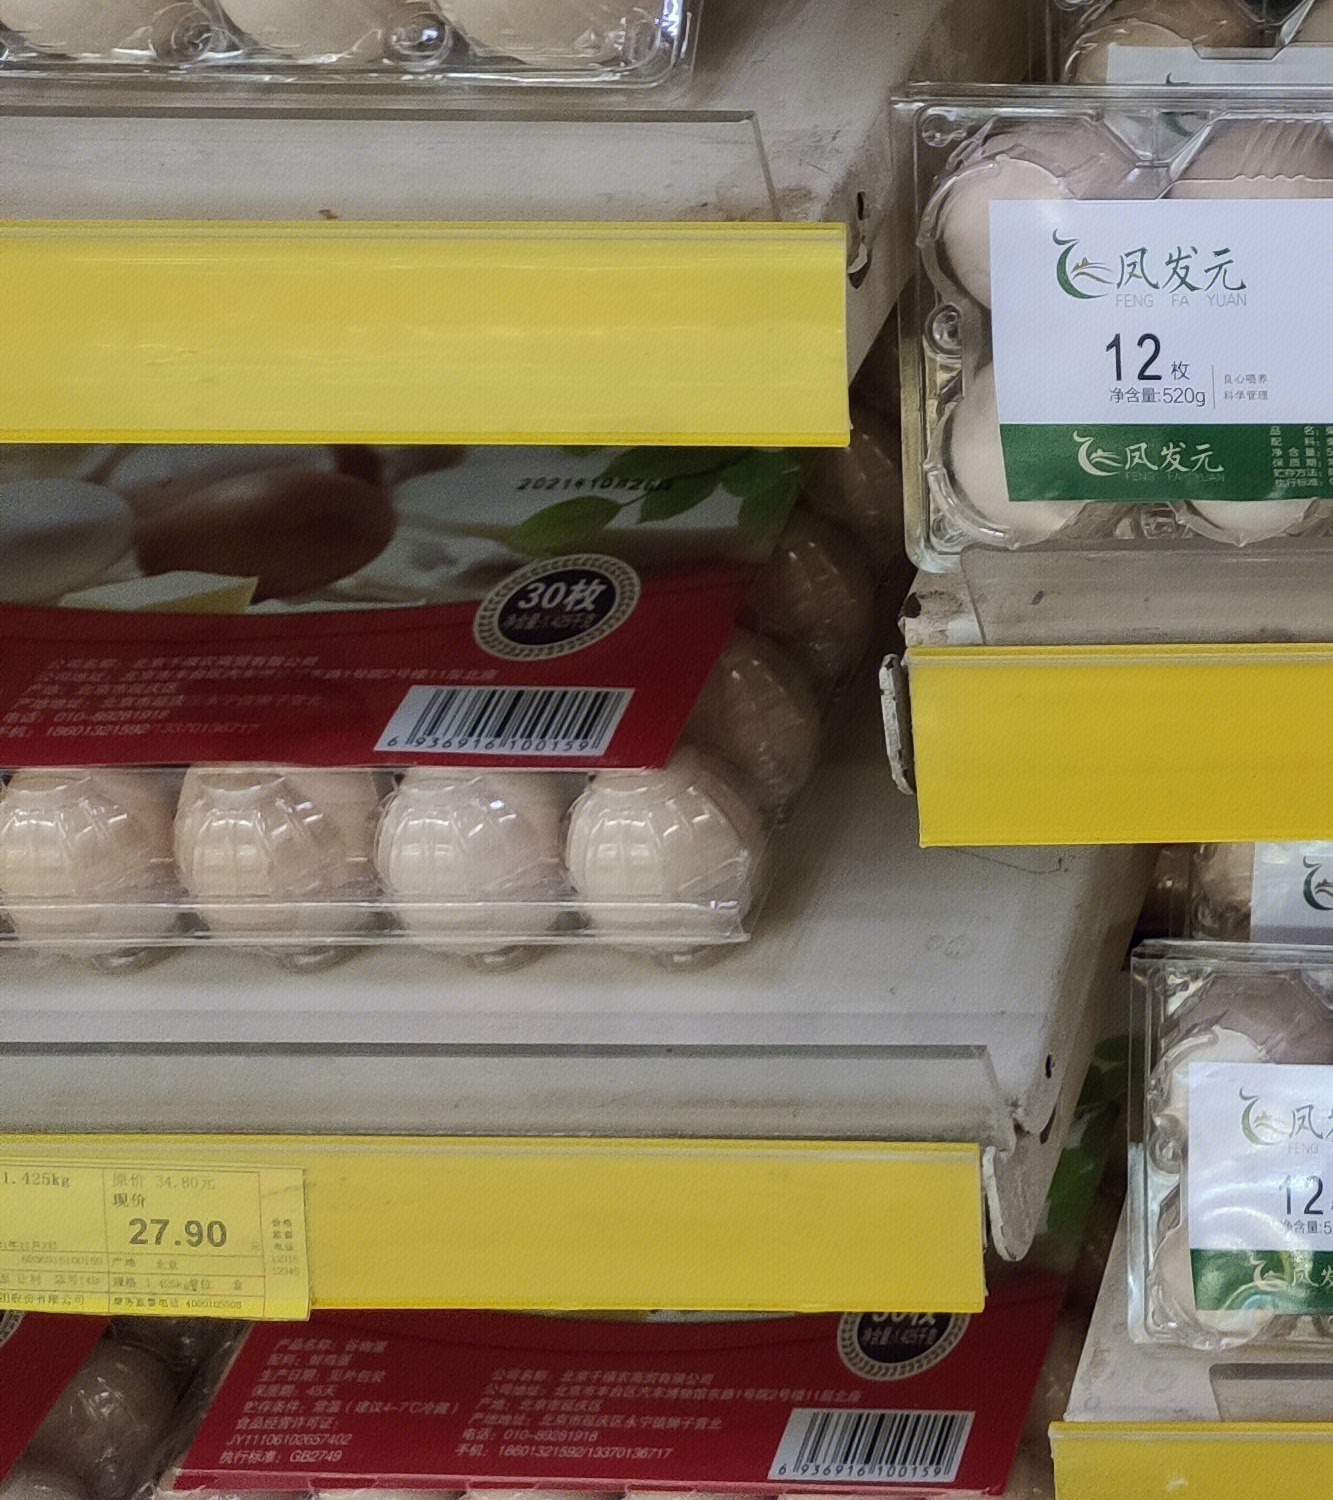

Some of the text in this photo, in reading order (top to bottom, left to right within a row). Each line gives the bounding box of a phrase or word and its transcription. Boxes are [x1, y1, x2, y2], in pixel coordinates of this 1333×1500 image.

[1116, 245, 1247, 294] 凤发元
[1116, 293, 1246, 307] FENG FA YUAN
[1125, 443, 1224, 474] 凤发元
[518, 579, 607, 612] 30枚
[1288, 1143, 1318, 1155] FENG
[113, 1194, 145, 1208] 现价
[128, 1218, 227, 1247] 27.90
